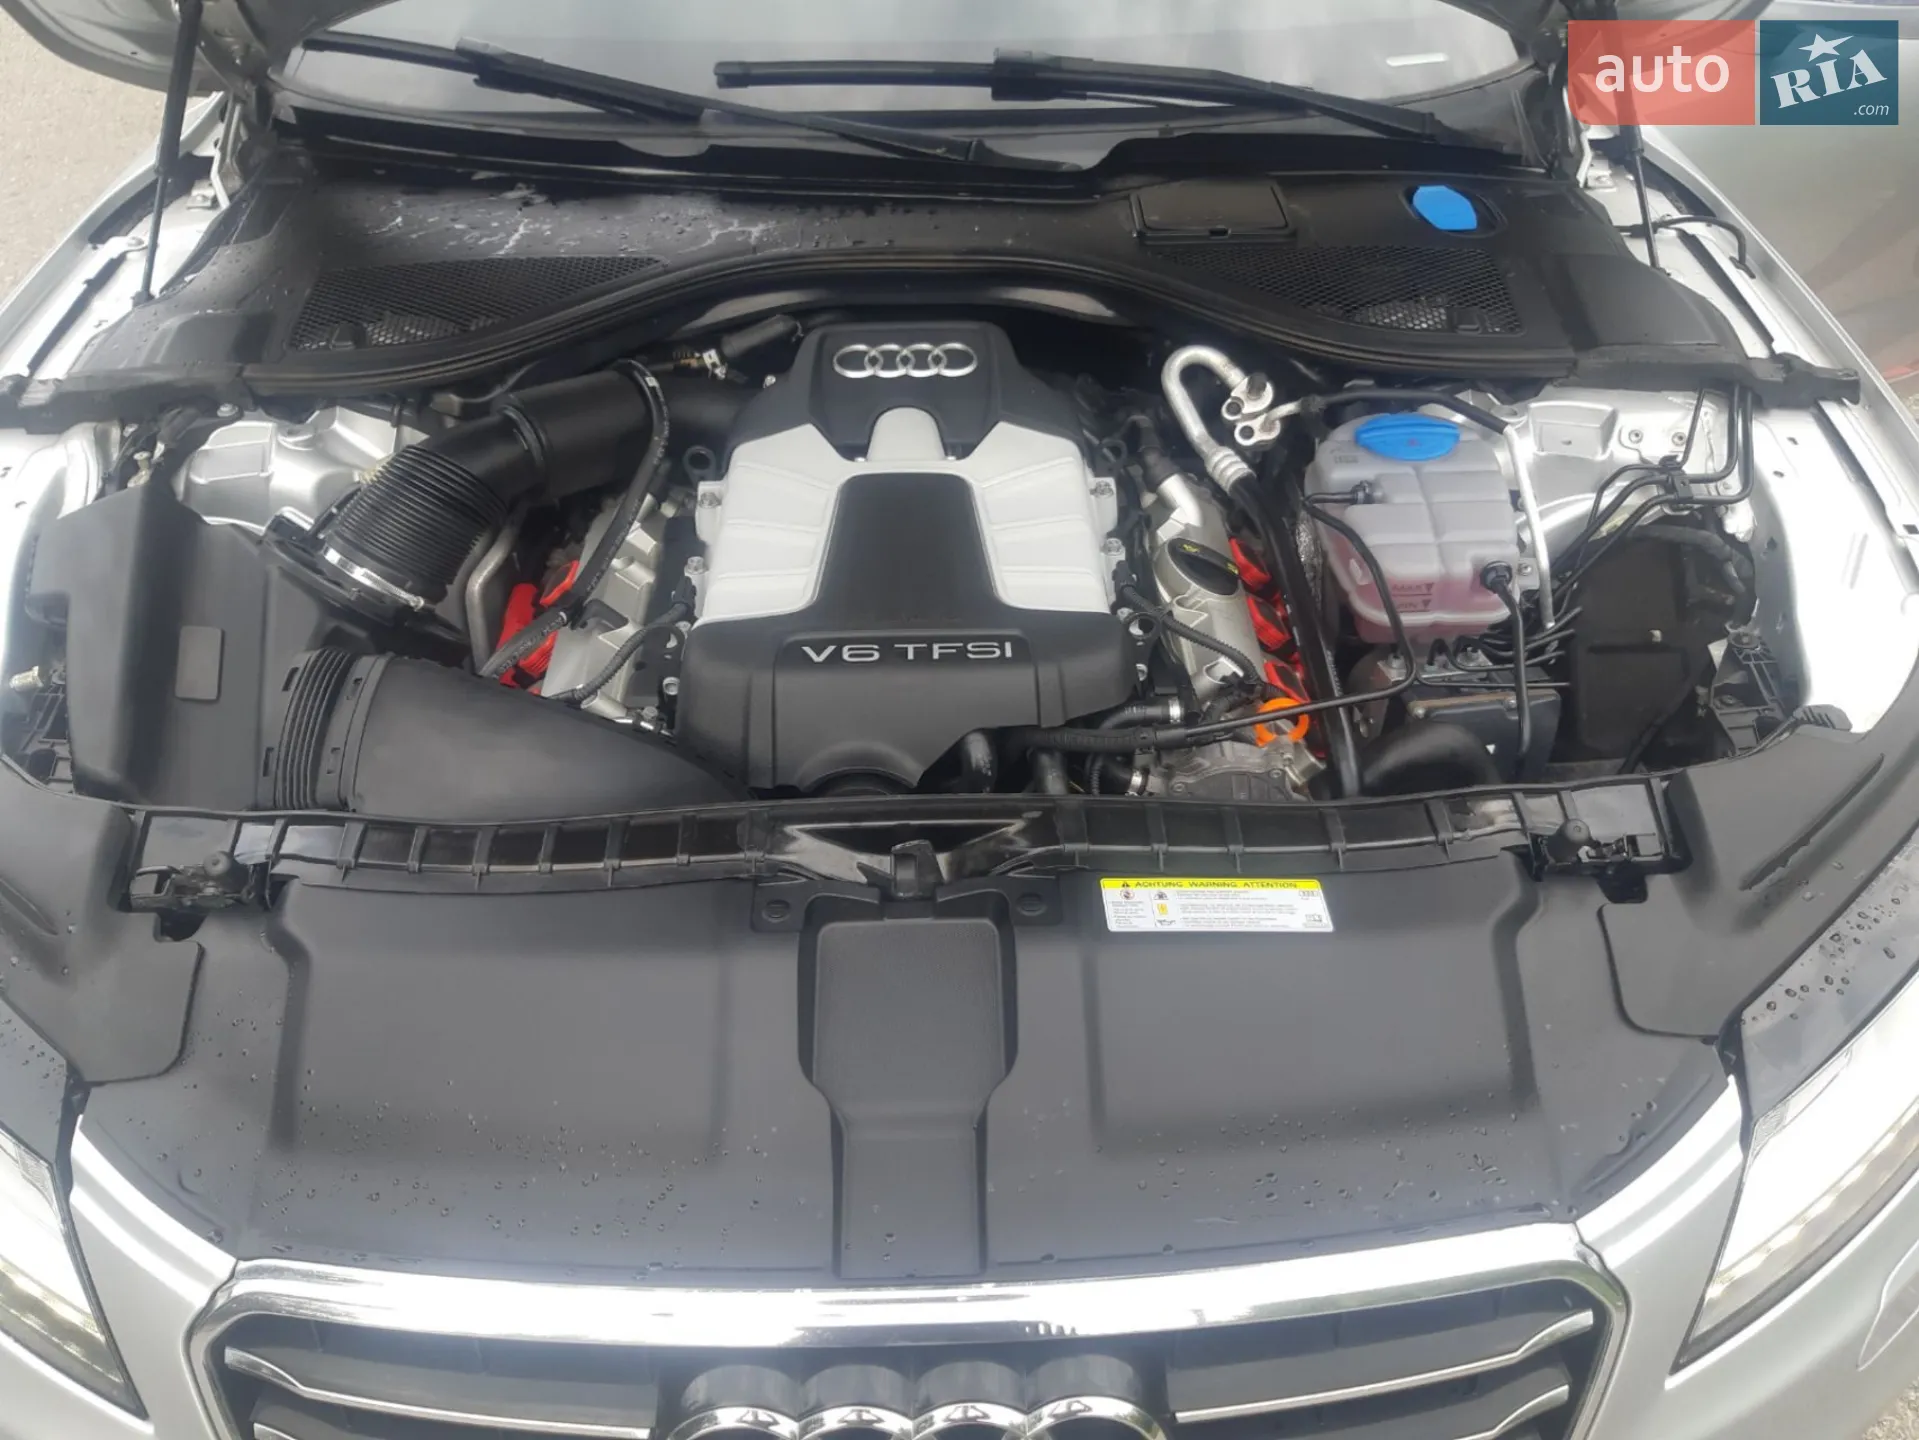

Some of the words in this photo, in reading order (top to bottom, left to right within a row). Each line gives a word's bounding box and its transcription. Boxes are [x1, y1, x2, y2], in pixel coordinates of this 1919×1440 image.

[801, 644, 880, 663] V6
[894, 641, 1013, 660] TFSI
[1135, 881, 1184, 889] ACHTUNG
[1188, 881, 1238, 889] WARNING
[1243, 881, 1298, 889] ATTENTION
